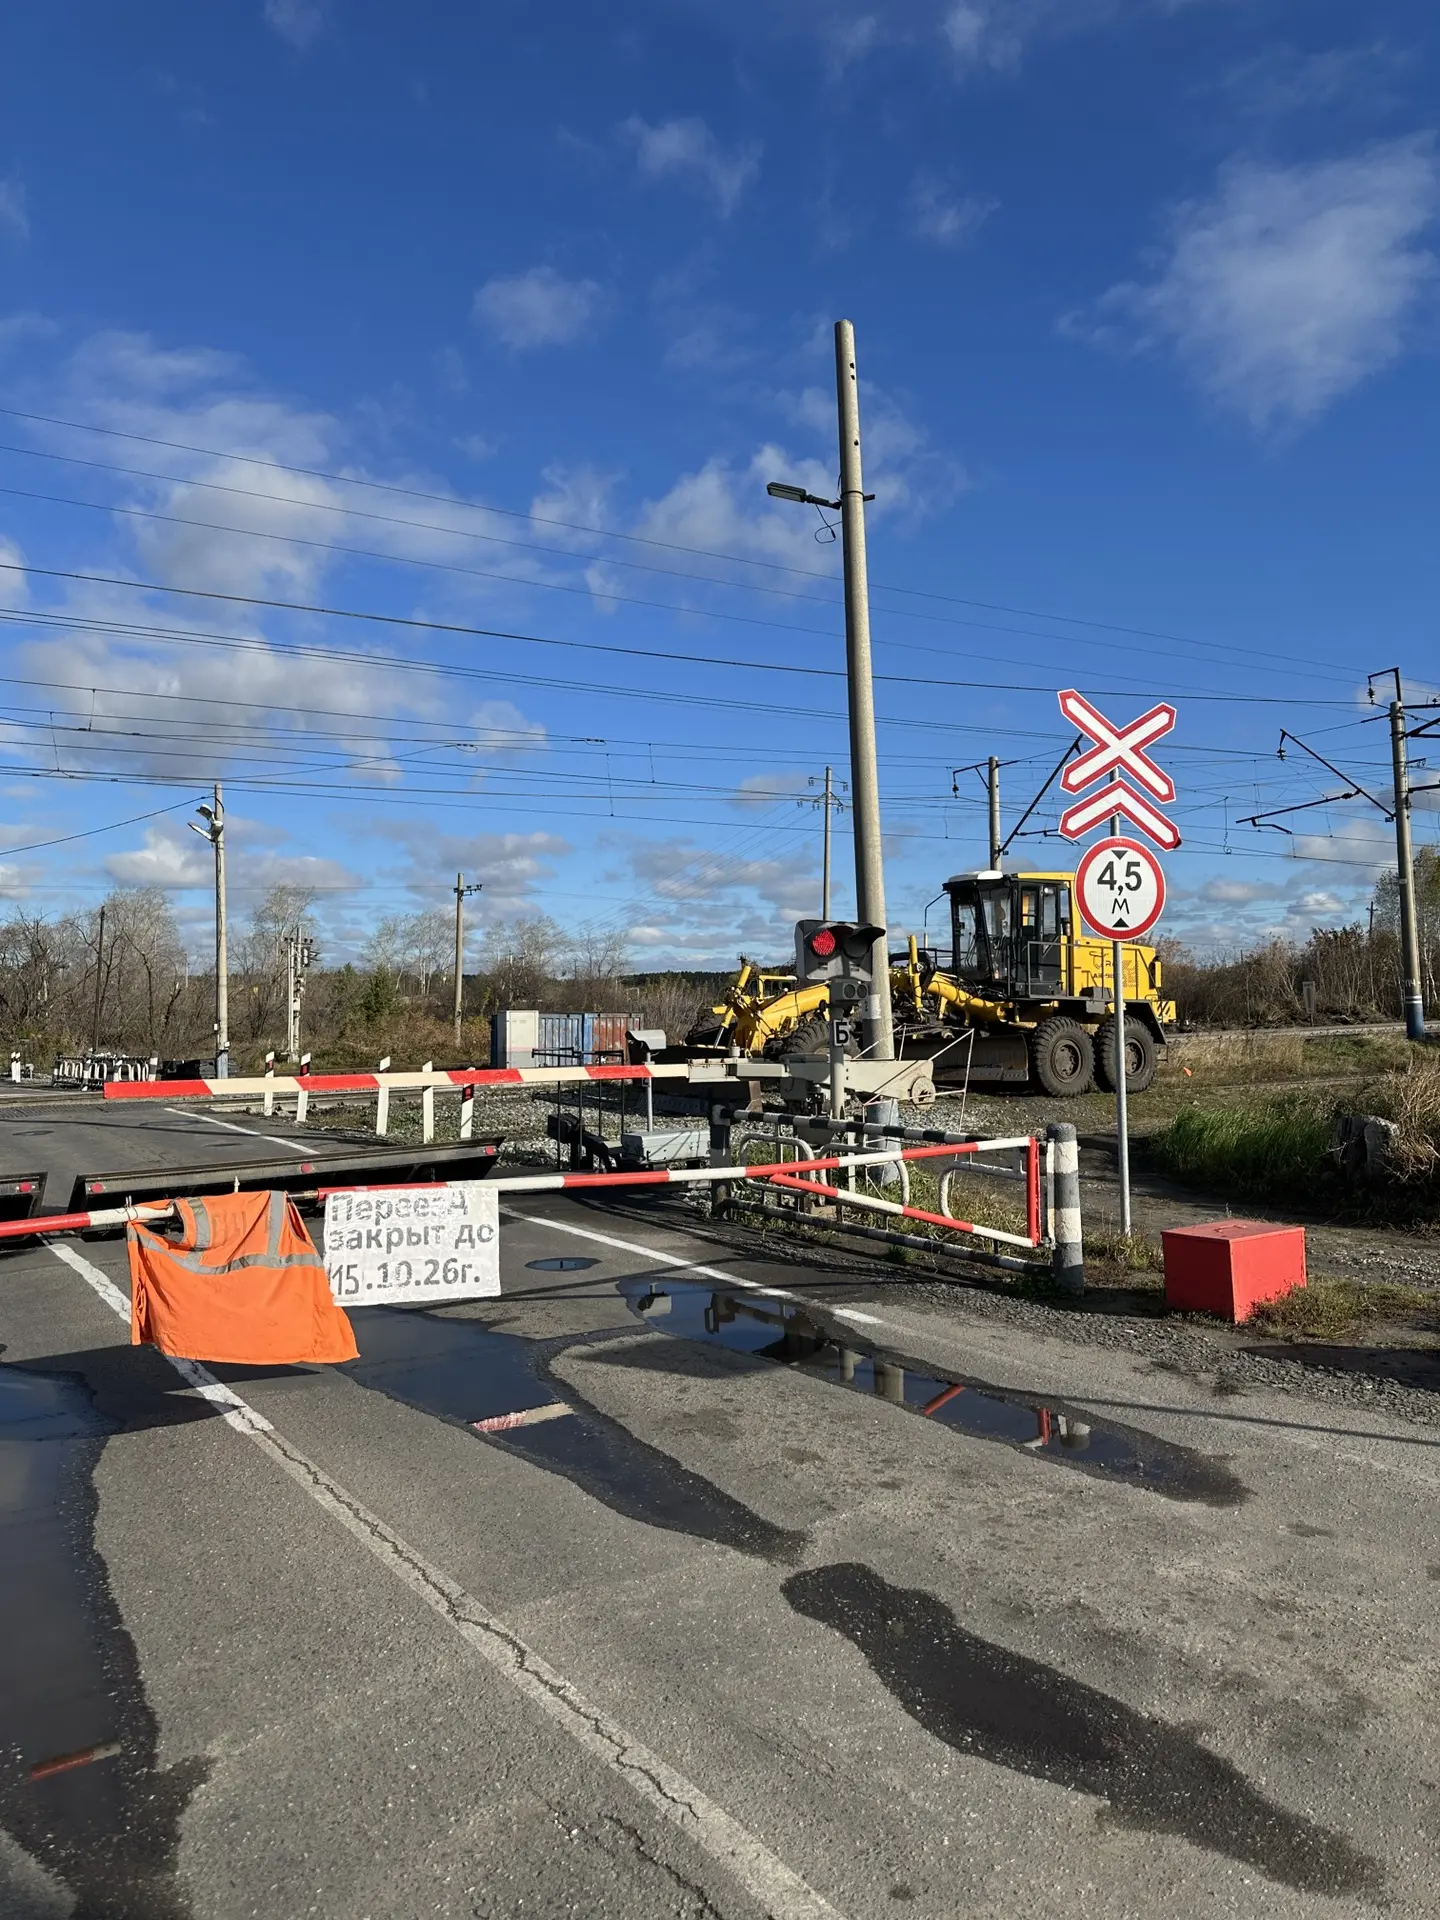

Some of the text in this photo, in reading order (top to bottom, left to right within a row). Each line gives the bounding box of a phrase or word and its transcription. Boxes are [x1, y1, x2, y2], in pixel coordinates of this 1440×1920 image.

[1097, 861, 1142, 896] 4,5
[836, 1022, 849, 1045] Б
[329, 1223, 494, 1254] закрыт до
